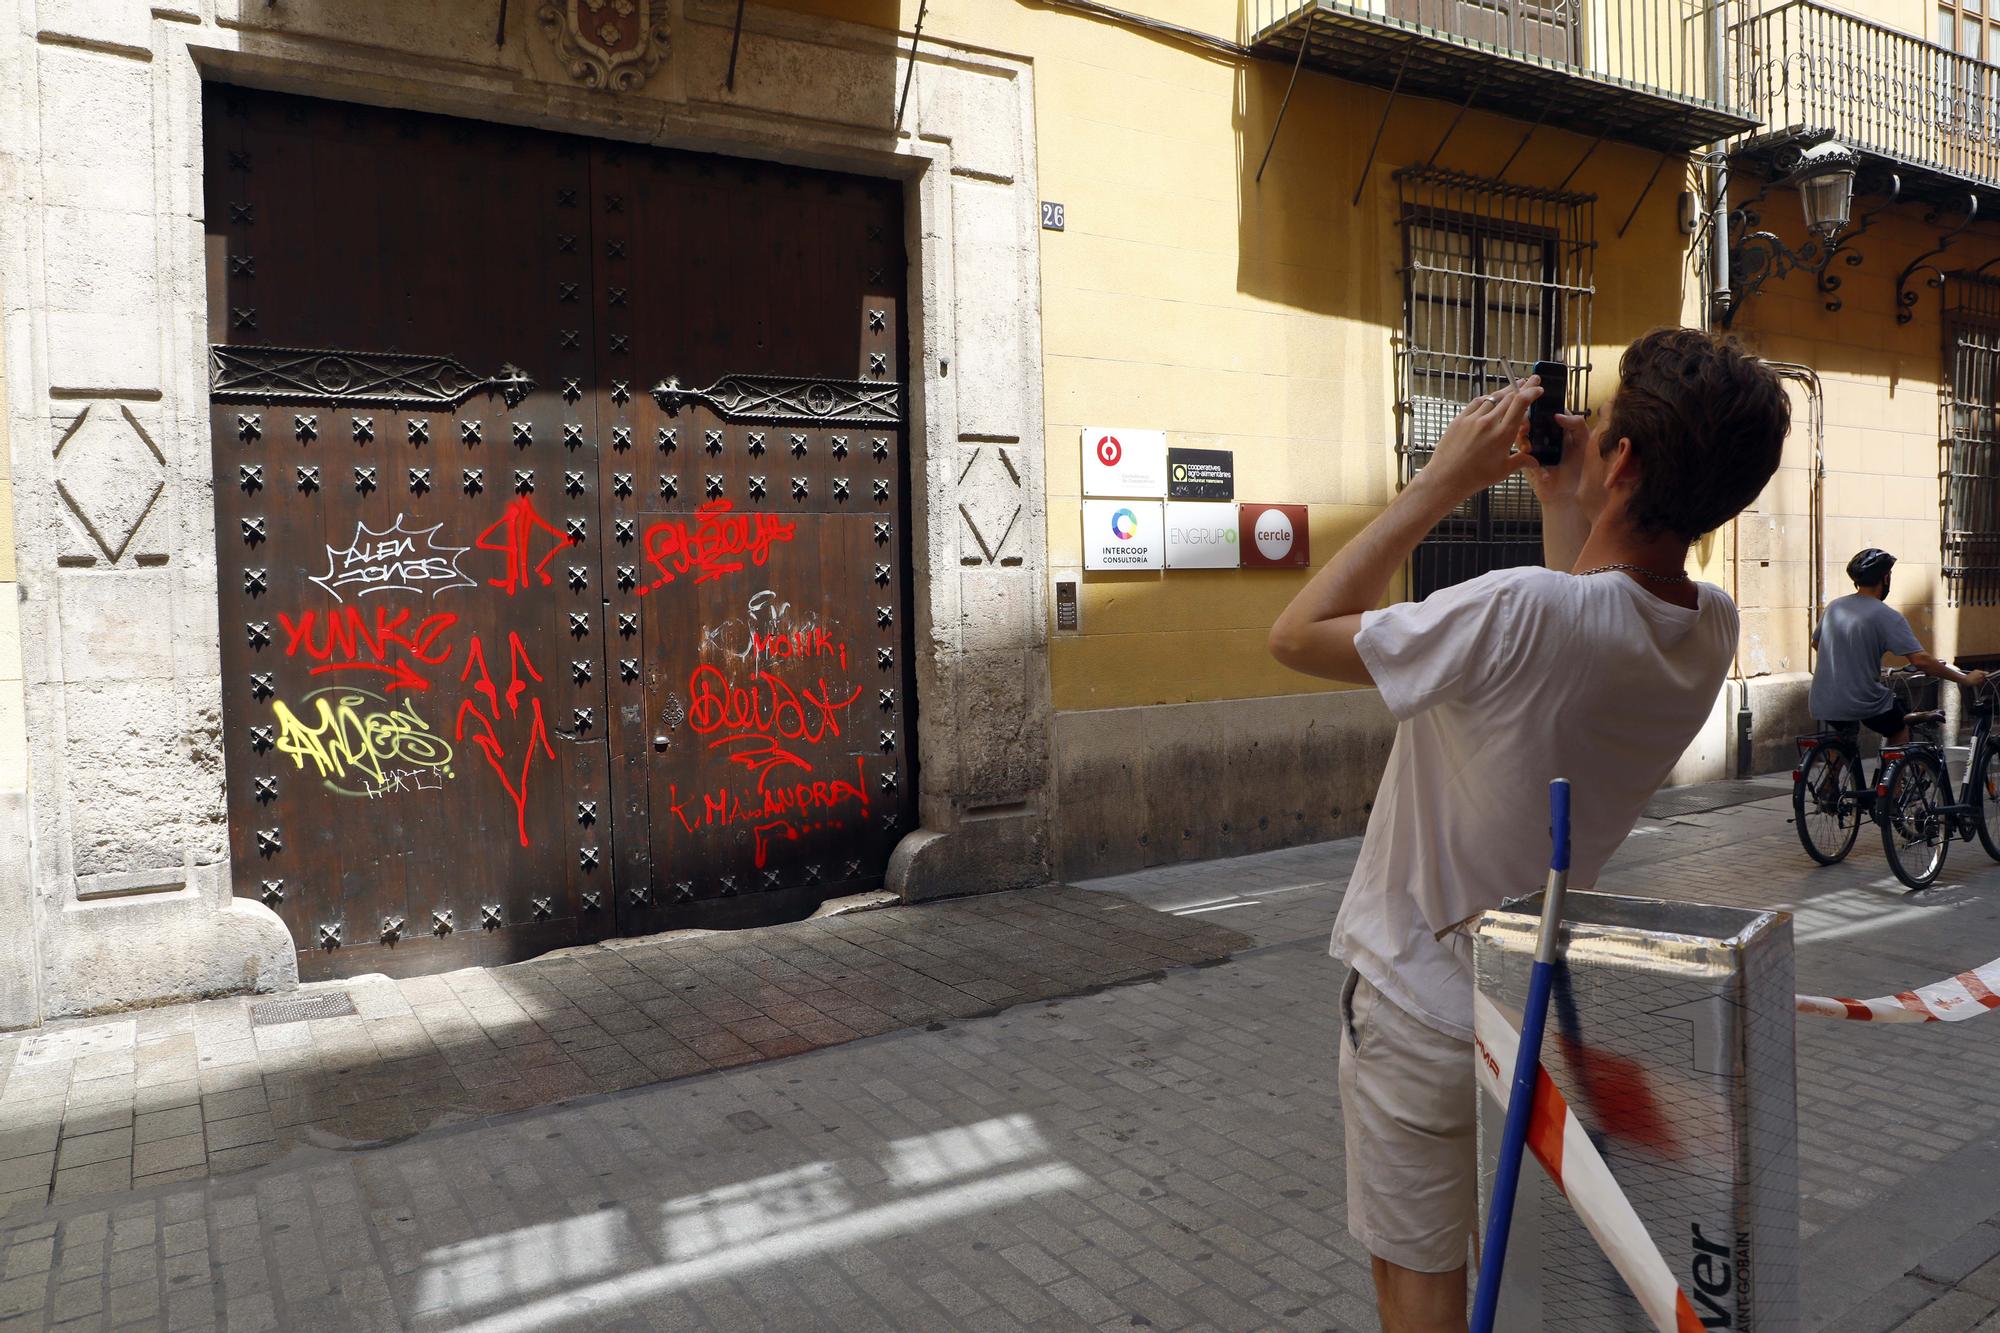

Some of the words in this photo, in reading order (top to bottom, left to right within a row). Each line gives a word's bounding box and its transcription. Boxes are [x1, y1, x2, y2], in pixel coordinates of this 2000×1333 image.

[1042, 203, 1064, 227] 26
[1170, 527, 1237, 544] ENGRUPO
[1257, 528, 1291, 541] cercle
[1102, 547, 1148, 555] INTERCOOP
[1102, 555, 1148, 563] CONSULTORÍA
